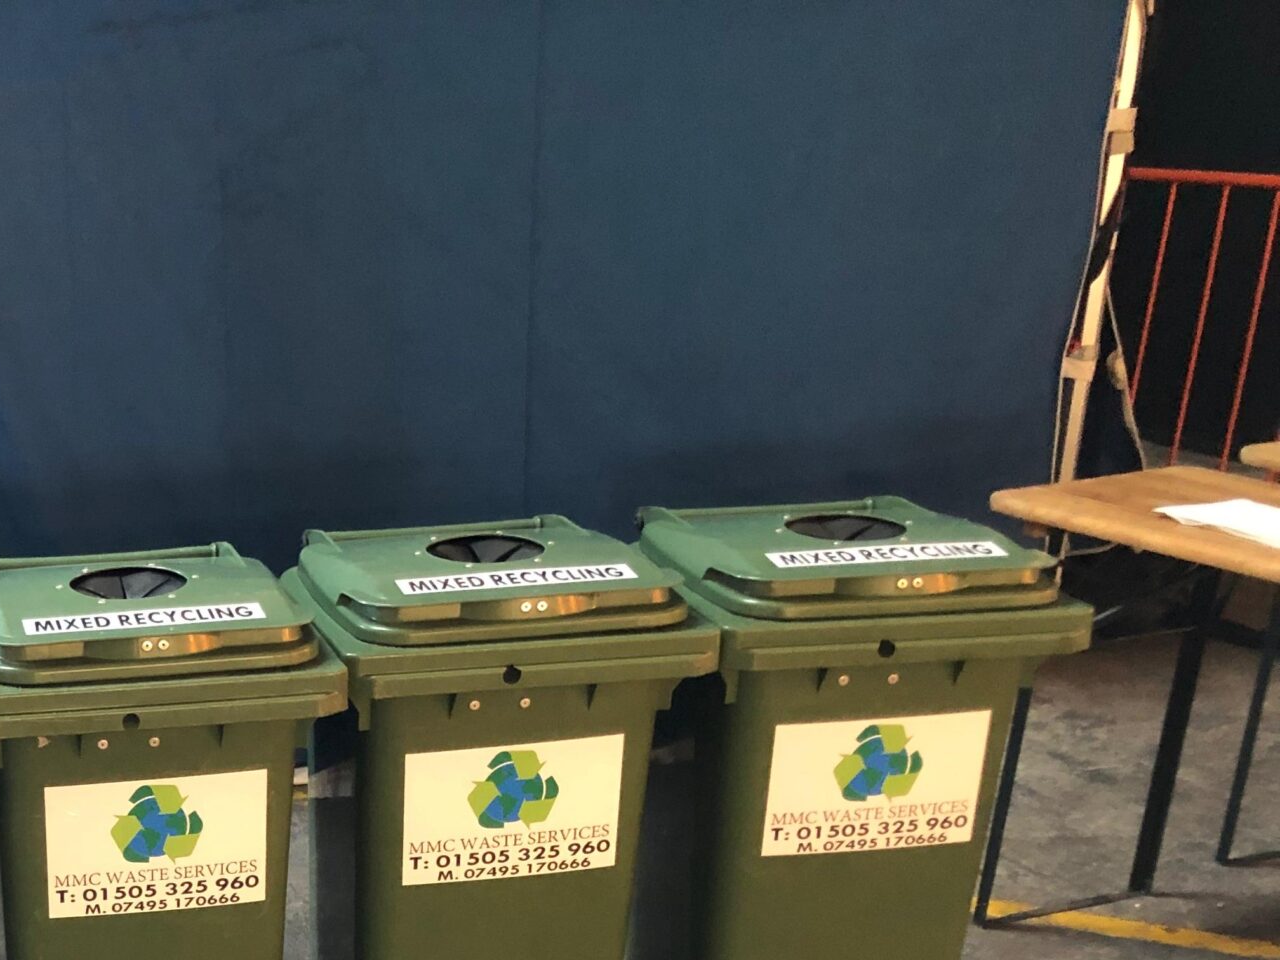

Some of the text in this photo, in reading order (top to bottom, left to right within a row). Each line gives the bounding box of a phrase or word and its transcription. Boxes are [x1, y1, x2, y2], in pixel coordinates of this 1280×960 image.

[779, 544, 993, 566] MIXED RECYCLING
[408, 566, 624, 592] MIXED RECYCLING
[34, 606, 254, 632] MIXED RECYCLING
[771, 800, 969, 826] MMC WASTE SERVICES
[409, 823, 610, 855] MMC WASTE SERVICES
[771, 814, 968, 841] T: 01505 325 960
[409, 839, 611, 870] T: 01505 325 960
[797, 832, 948, 853] M. 07495 170666
[54, 859, 258, 888] MMC WASTE SERVICES
[437, 857, 591, 881] M. 07495 170666
[55, 874, 259, 904] T: 01505 325 960
[85, 892, 240, 915] M. 07495 170666
